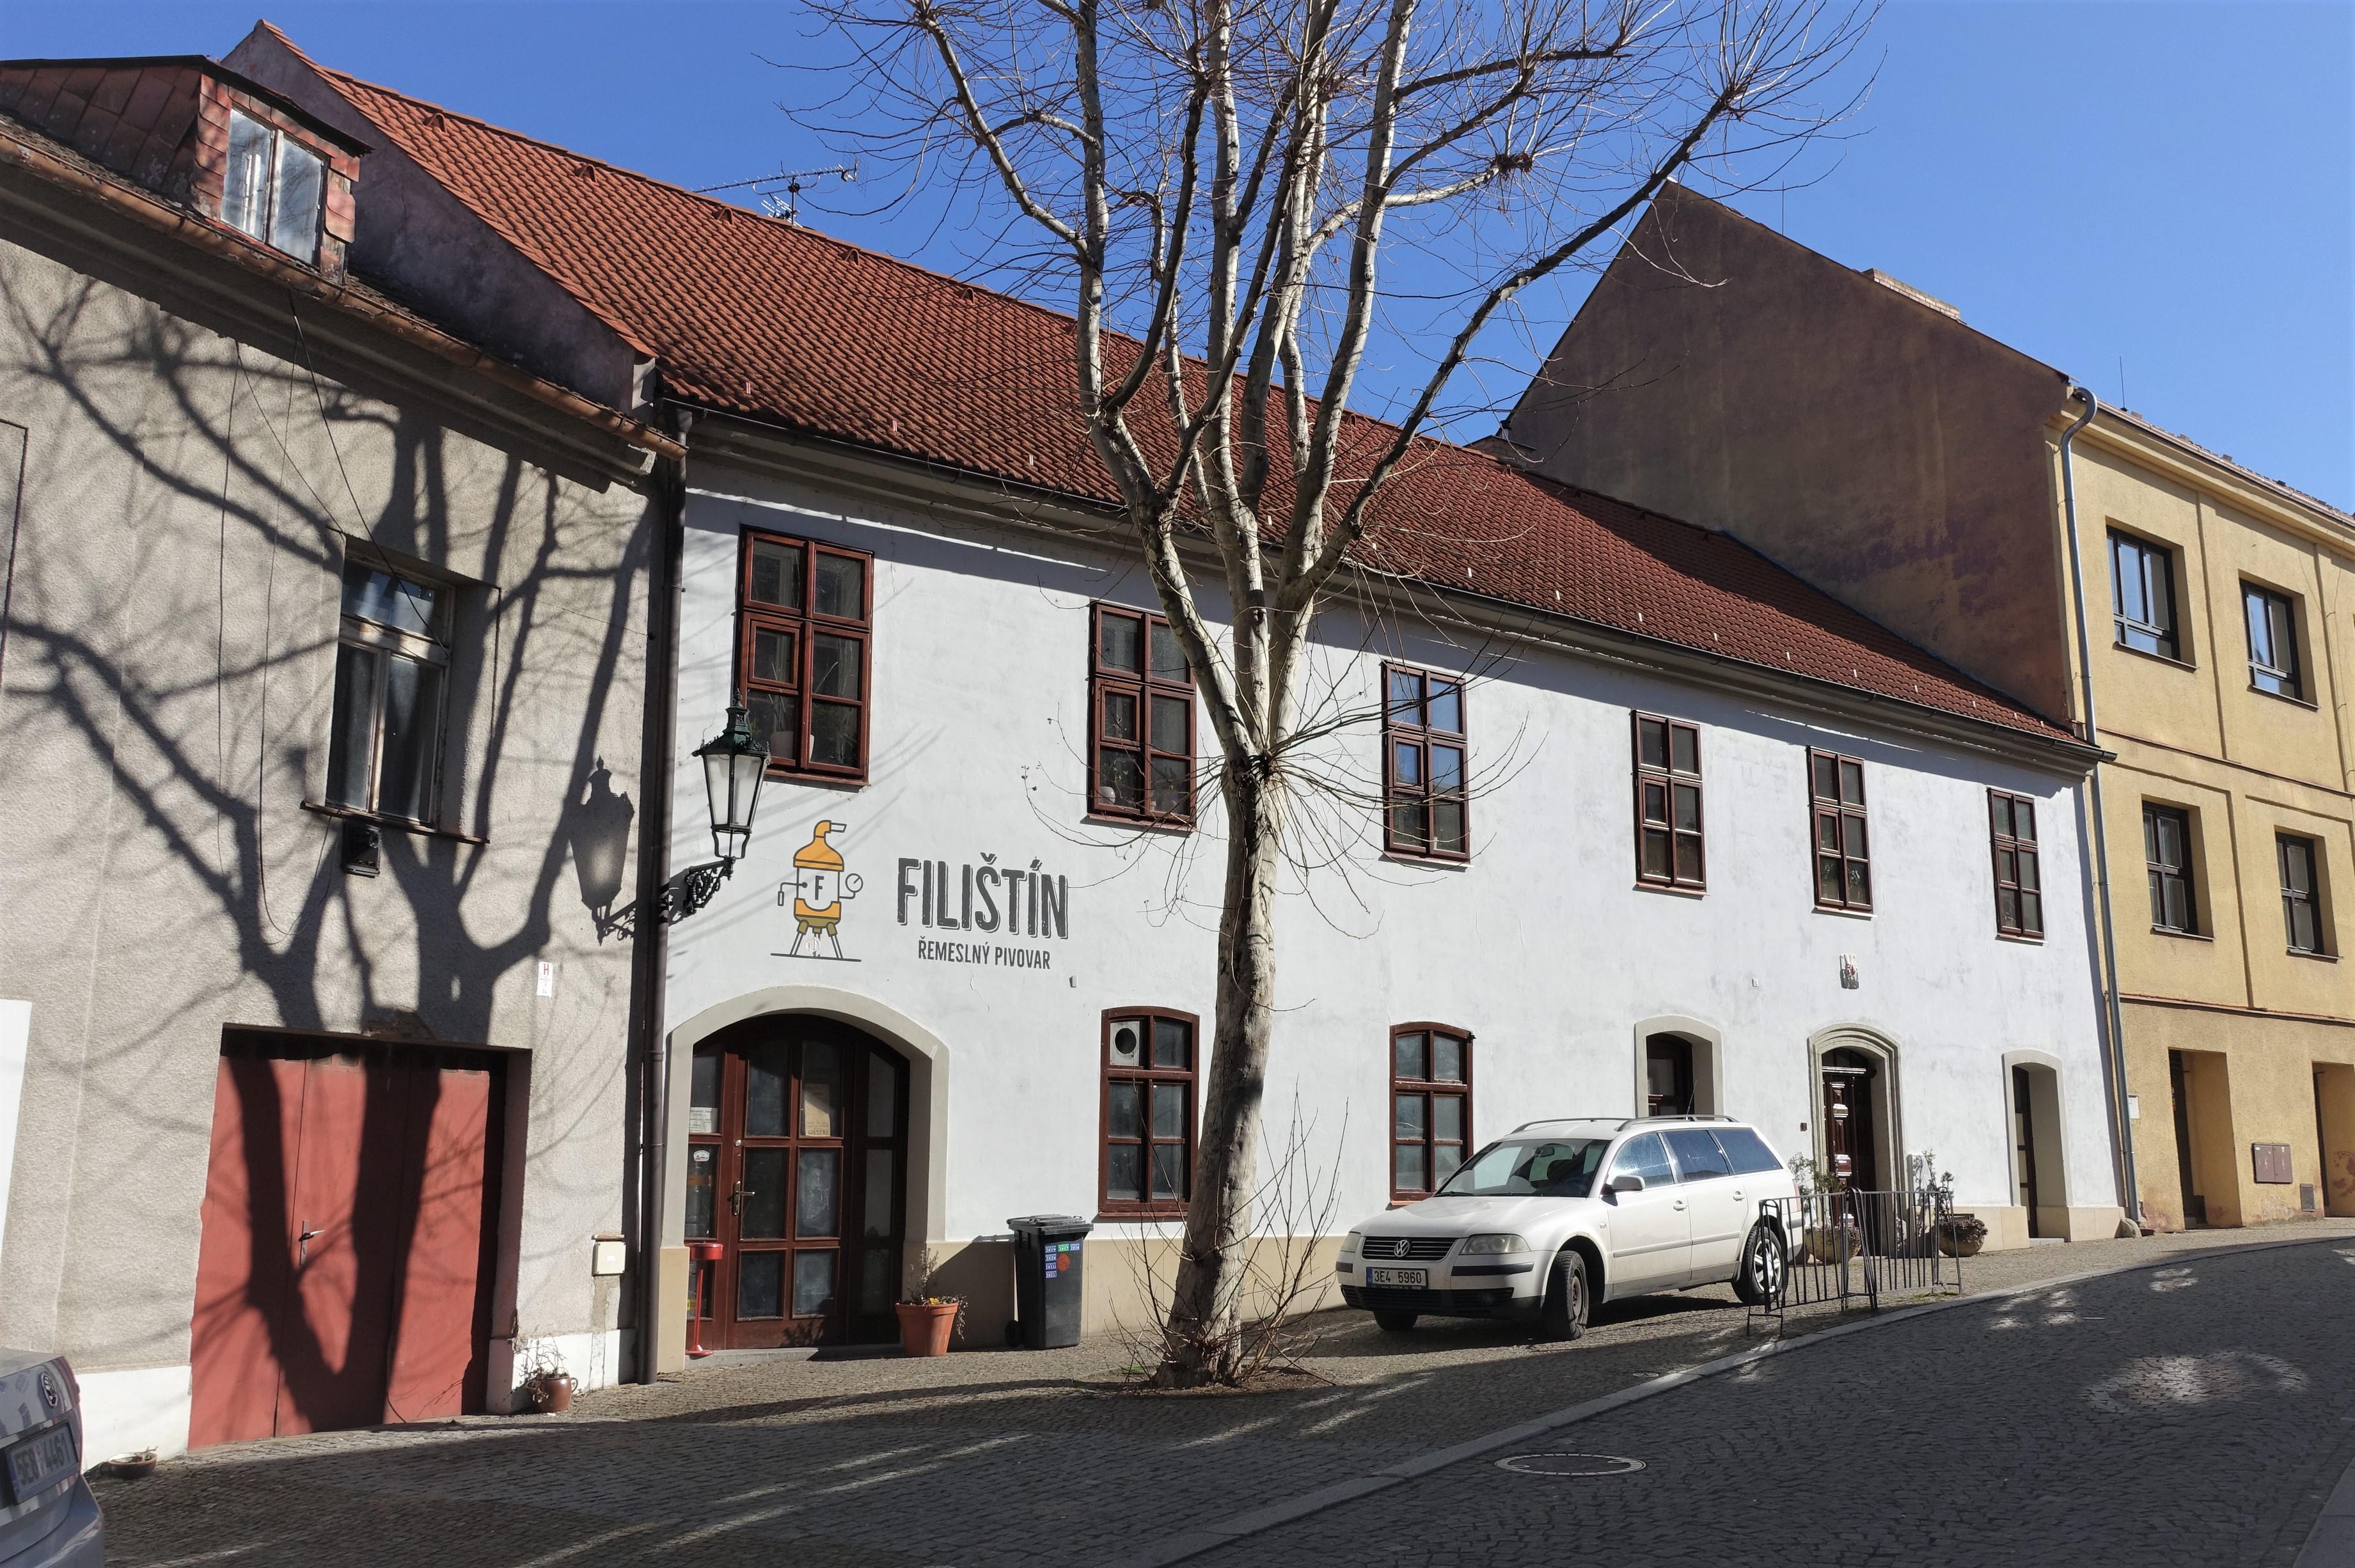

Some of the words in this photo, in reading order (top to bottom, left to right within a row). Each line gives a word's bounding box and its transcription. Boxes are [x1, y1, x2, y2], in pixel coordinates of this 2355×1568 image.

[815, 875, 824, 900] F
[897, 852, 1068, 939] FILIŠTÍN
[918, 936, 990, 964] ŘEMESLNÝ
[995, 946, 1050, 969] PIVOVAR
[544, 963, 549, 975] H
[1374, 1270, 1391, 1283] 3E4
[1398, 1271, 1422, 1283] 5960
